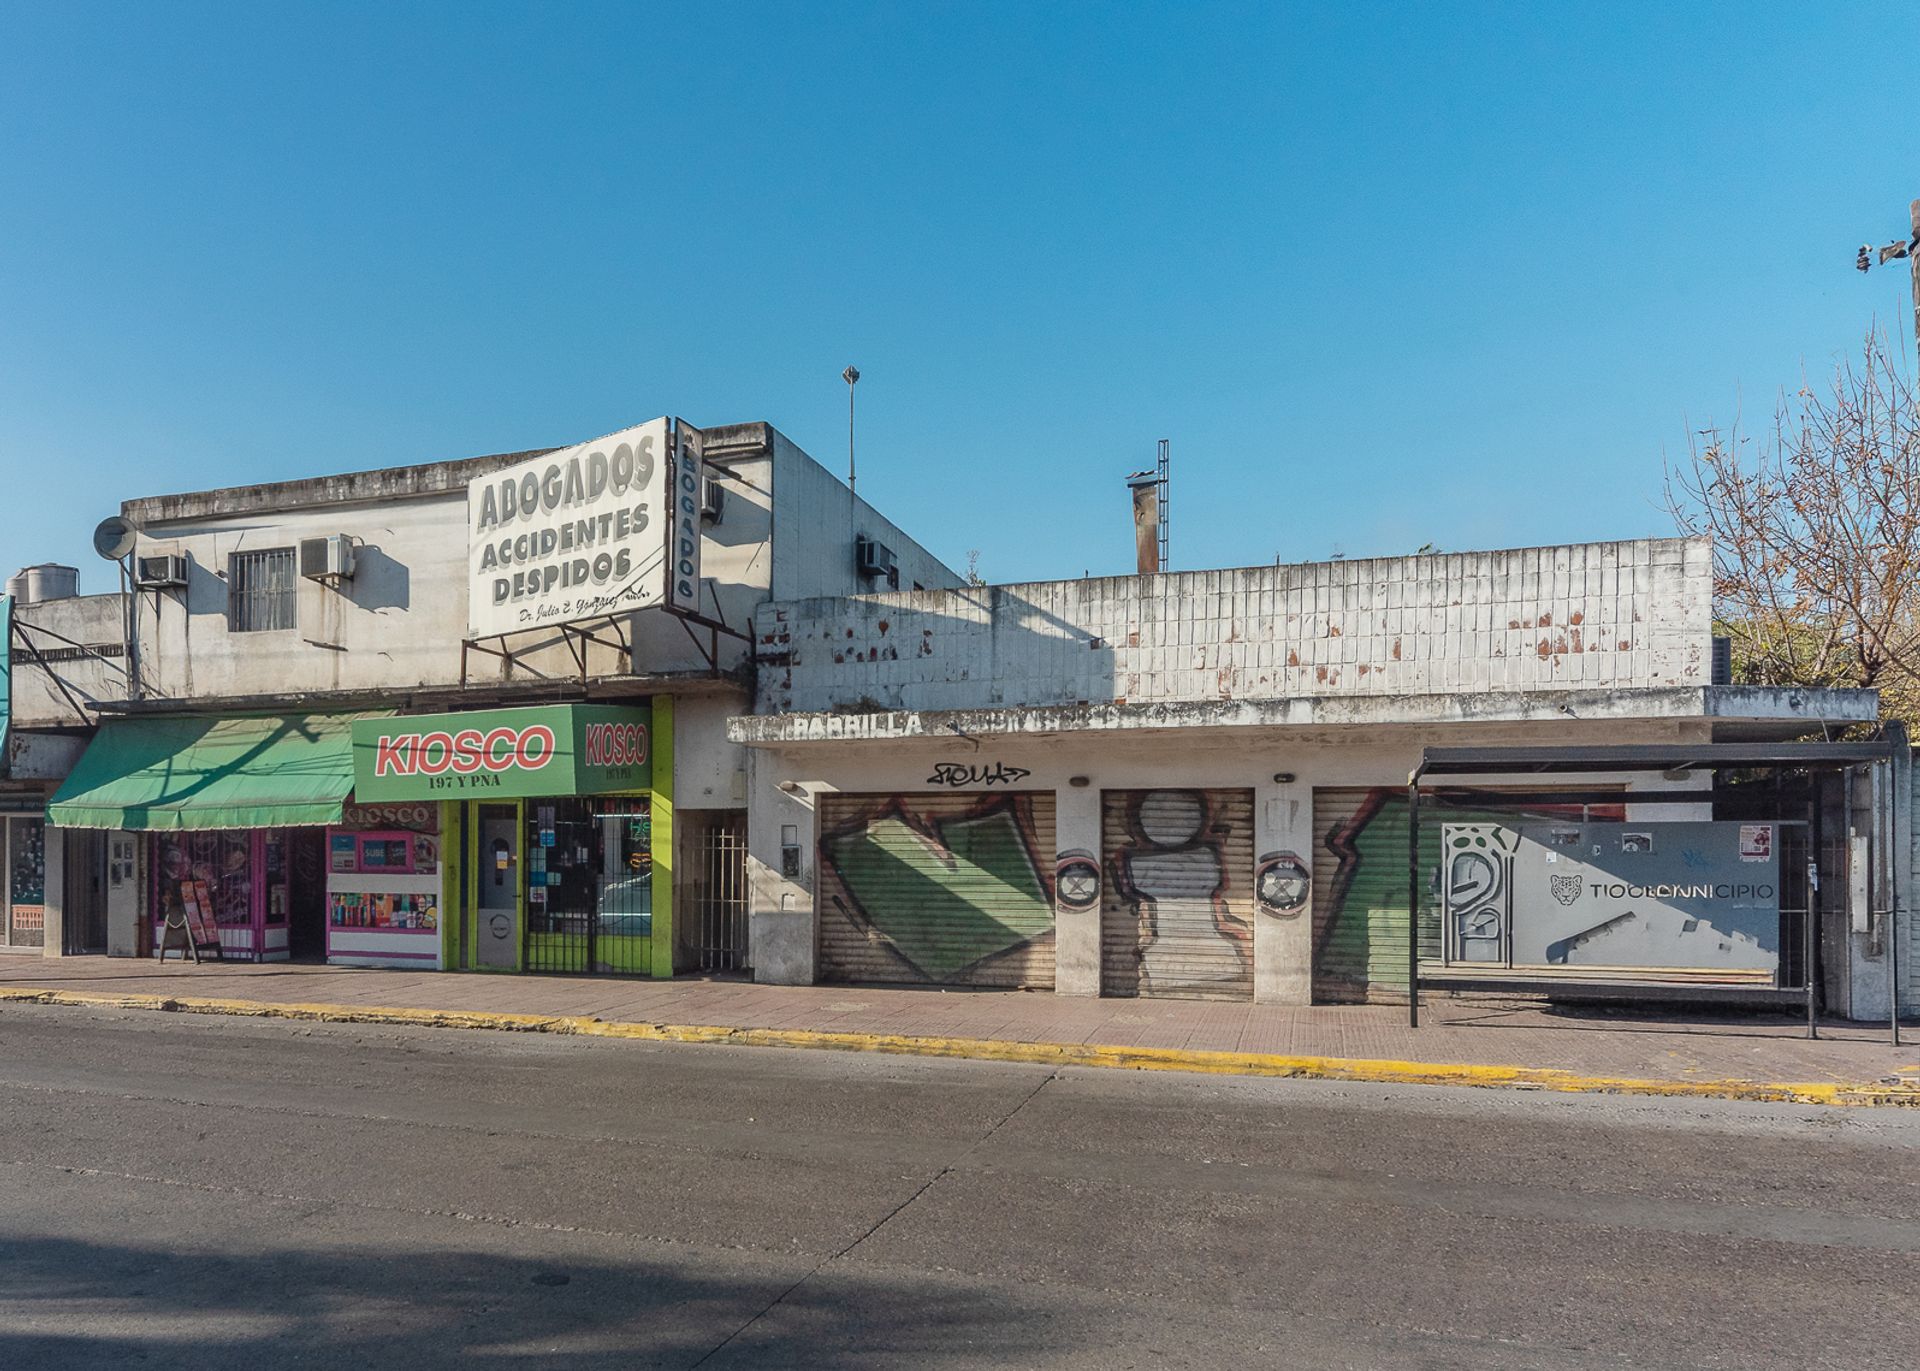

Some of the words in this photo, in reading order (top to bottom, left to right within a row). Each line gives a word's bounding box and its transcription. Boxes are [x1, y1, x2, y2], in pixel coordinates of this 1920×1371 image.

[477, 435, 655, 533] ABOGADOS
[478, 503, 649, 574] ACCIDENTES
[493, 548, 631, 605] DESPIDOS
[375, 724, 555, 776] KIOSCO
[585, 722, 648, 766] KIOSCO
[429, 777, 453, 789] 197
[457, 776, 467, 788] Y
[471, 774, 502, 787] PNA
[345, 807, 430, 823] KIOSCO
